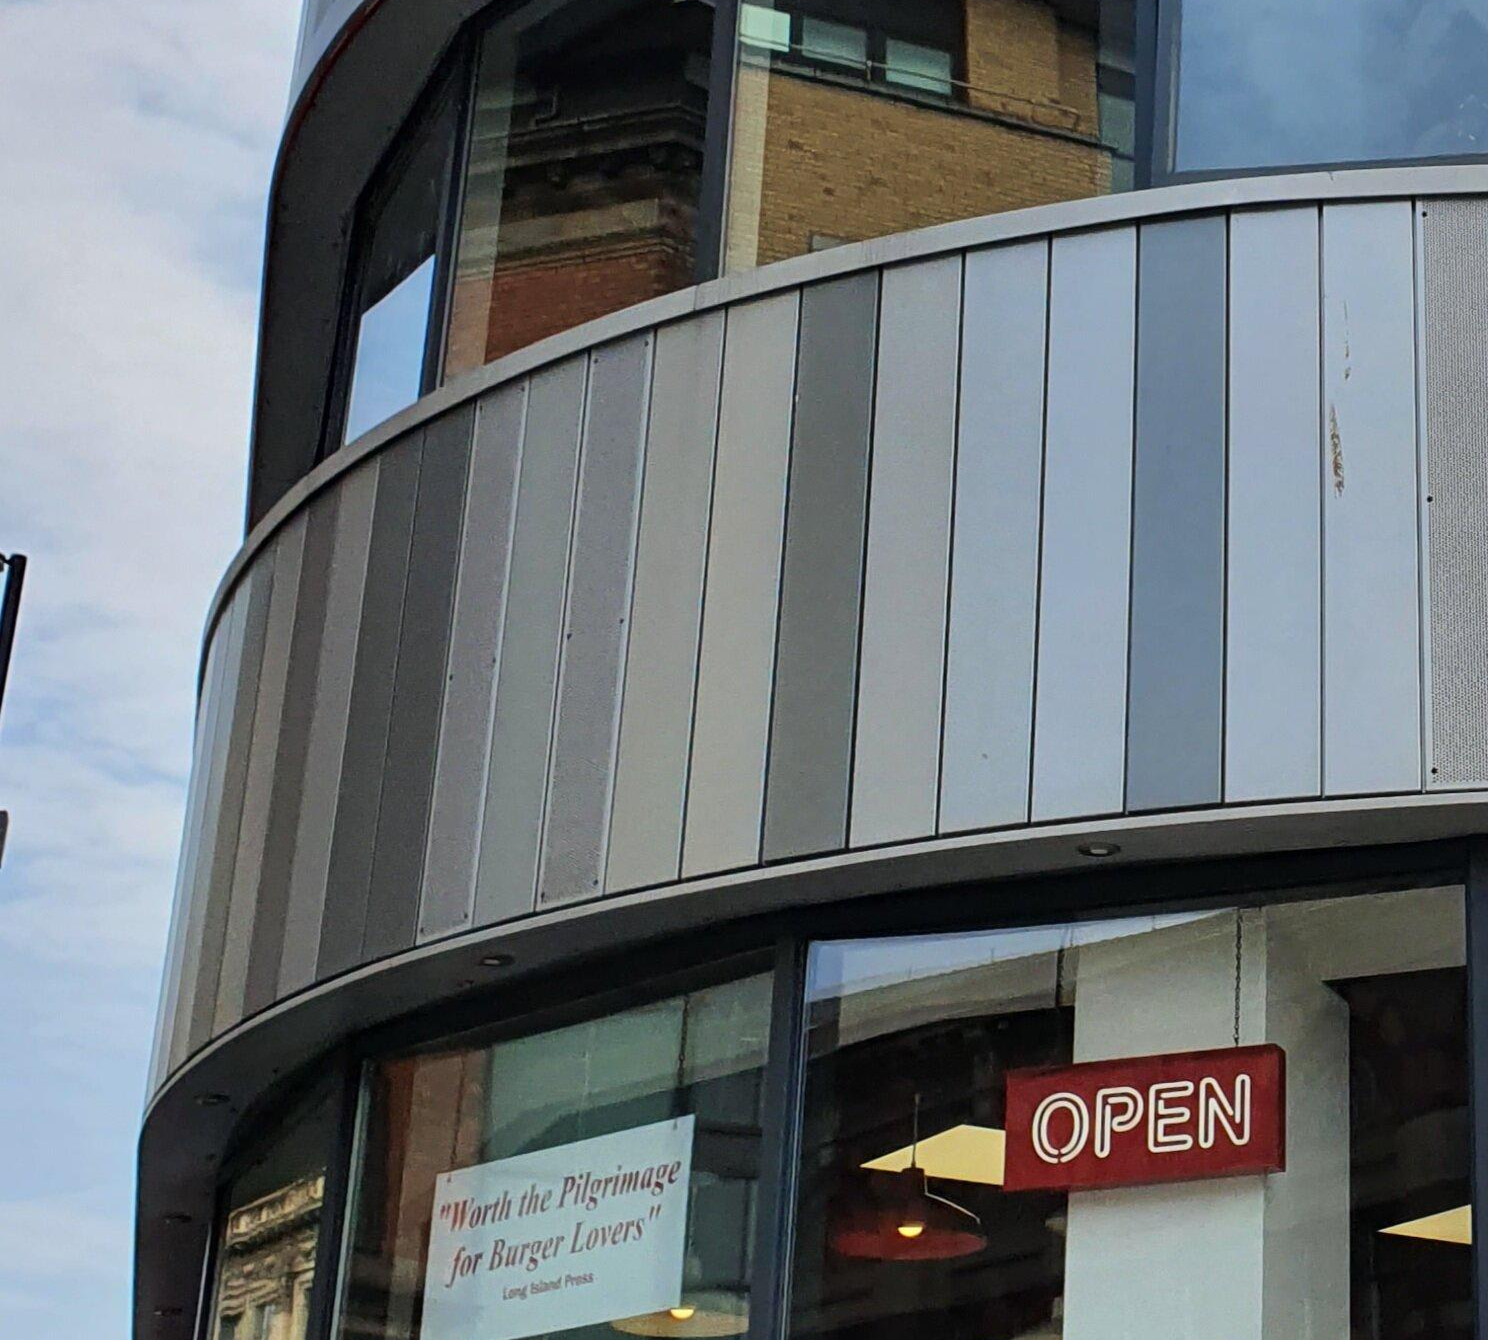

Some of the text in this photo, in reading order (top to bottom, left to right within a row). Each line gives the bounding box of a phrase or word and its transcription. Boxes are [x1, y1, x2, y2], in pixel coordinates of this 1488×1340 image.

[1031, 1073, 1251, 1164] OPEN
[439, 1160, 683, 1232] "Worth the Pilgrimage
[445, 1204, 662, 1289] for Burger Lovers"
[502, 1272, 594, 1301] Long Island Press
